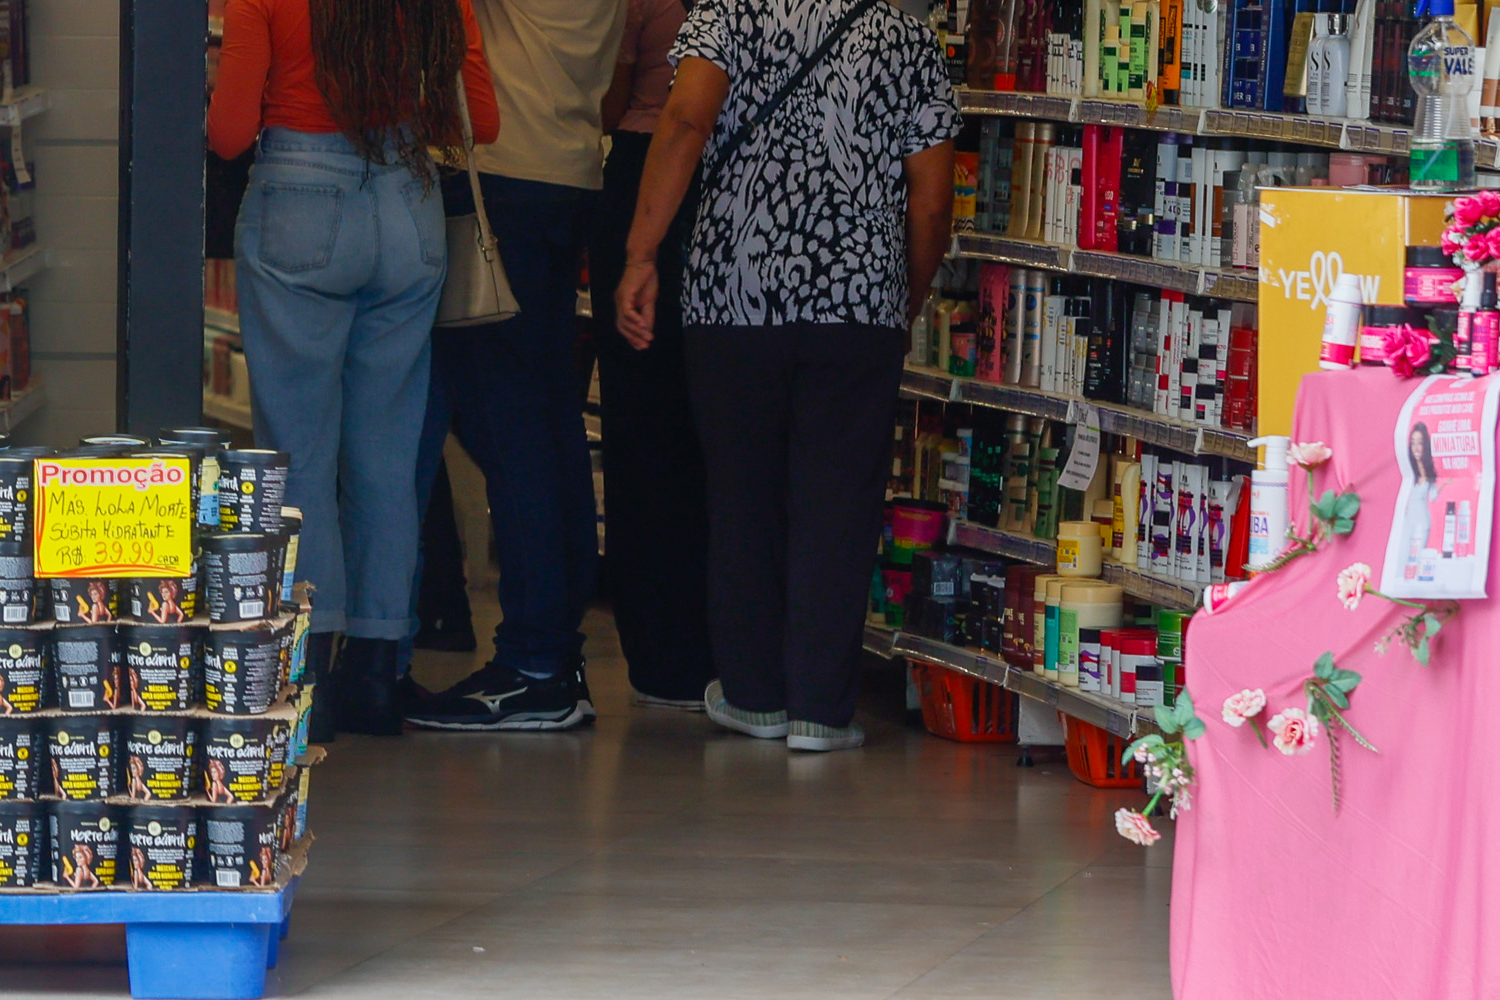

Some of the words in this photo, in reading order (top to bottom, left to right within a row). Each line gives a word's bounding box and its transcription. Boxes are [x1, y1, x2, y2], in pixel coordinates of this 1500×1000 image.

[1444, 46, 1468, 56] SUPER
[1433, 435, 1475, 453] MINIATURA
[42, 462, 182, 490] Promoção
